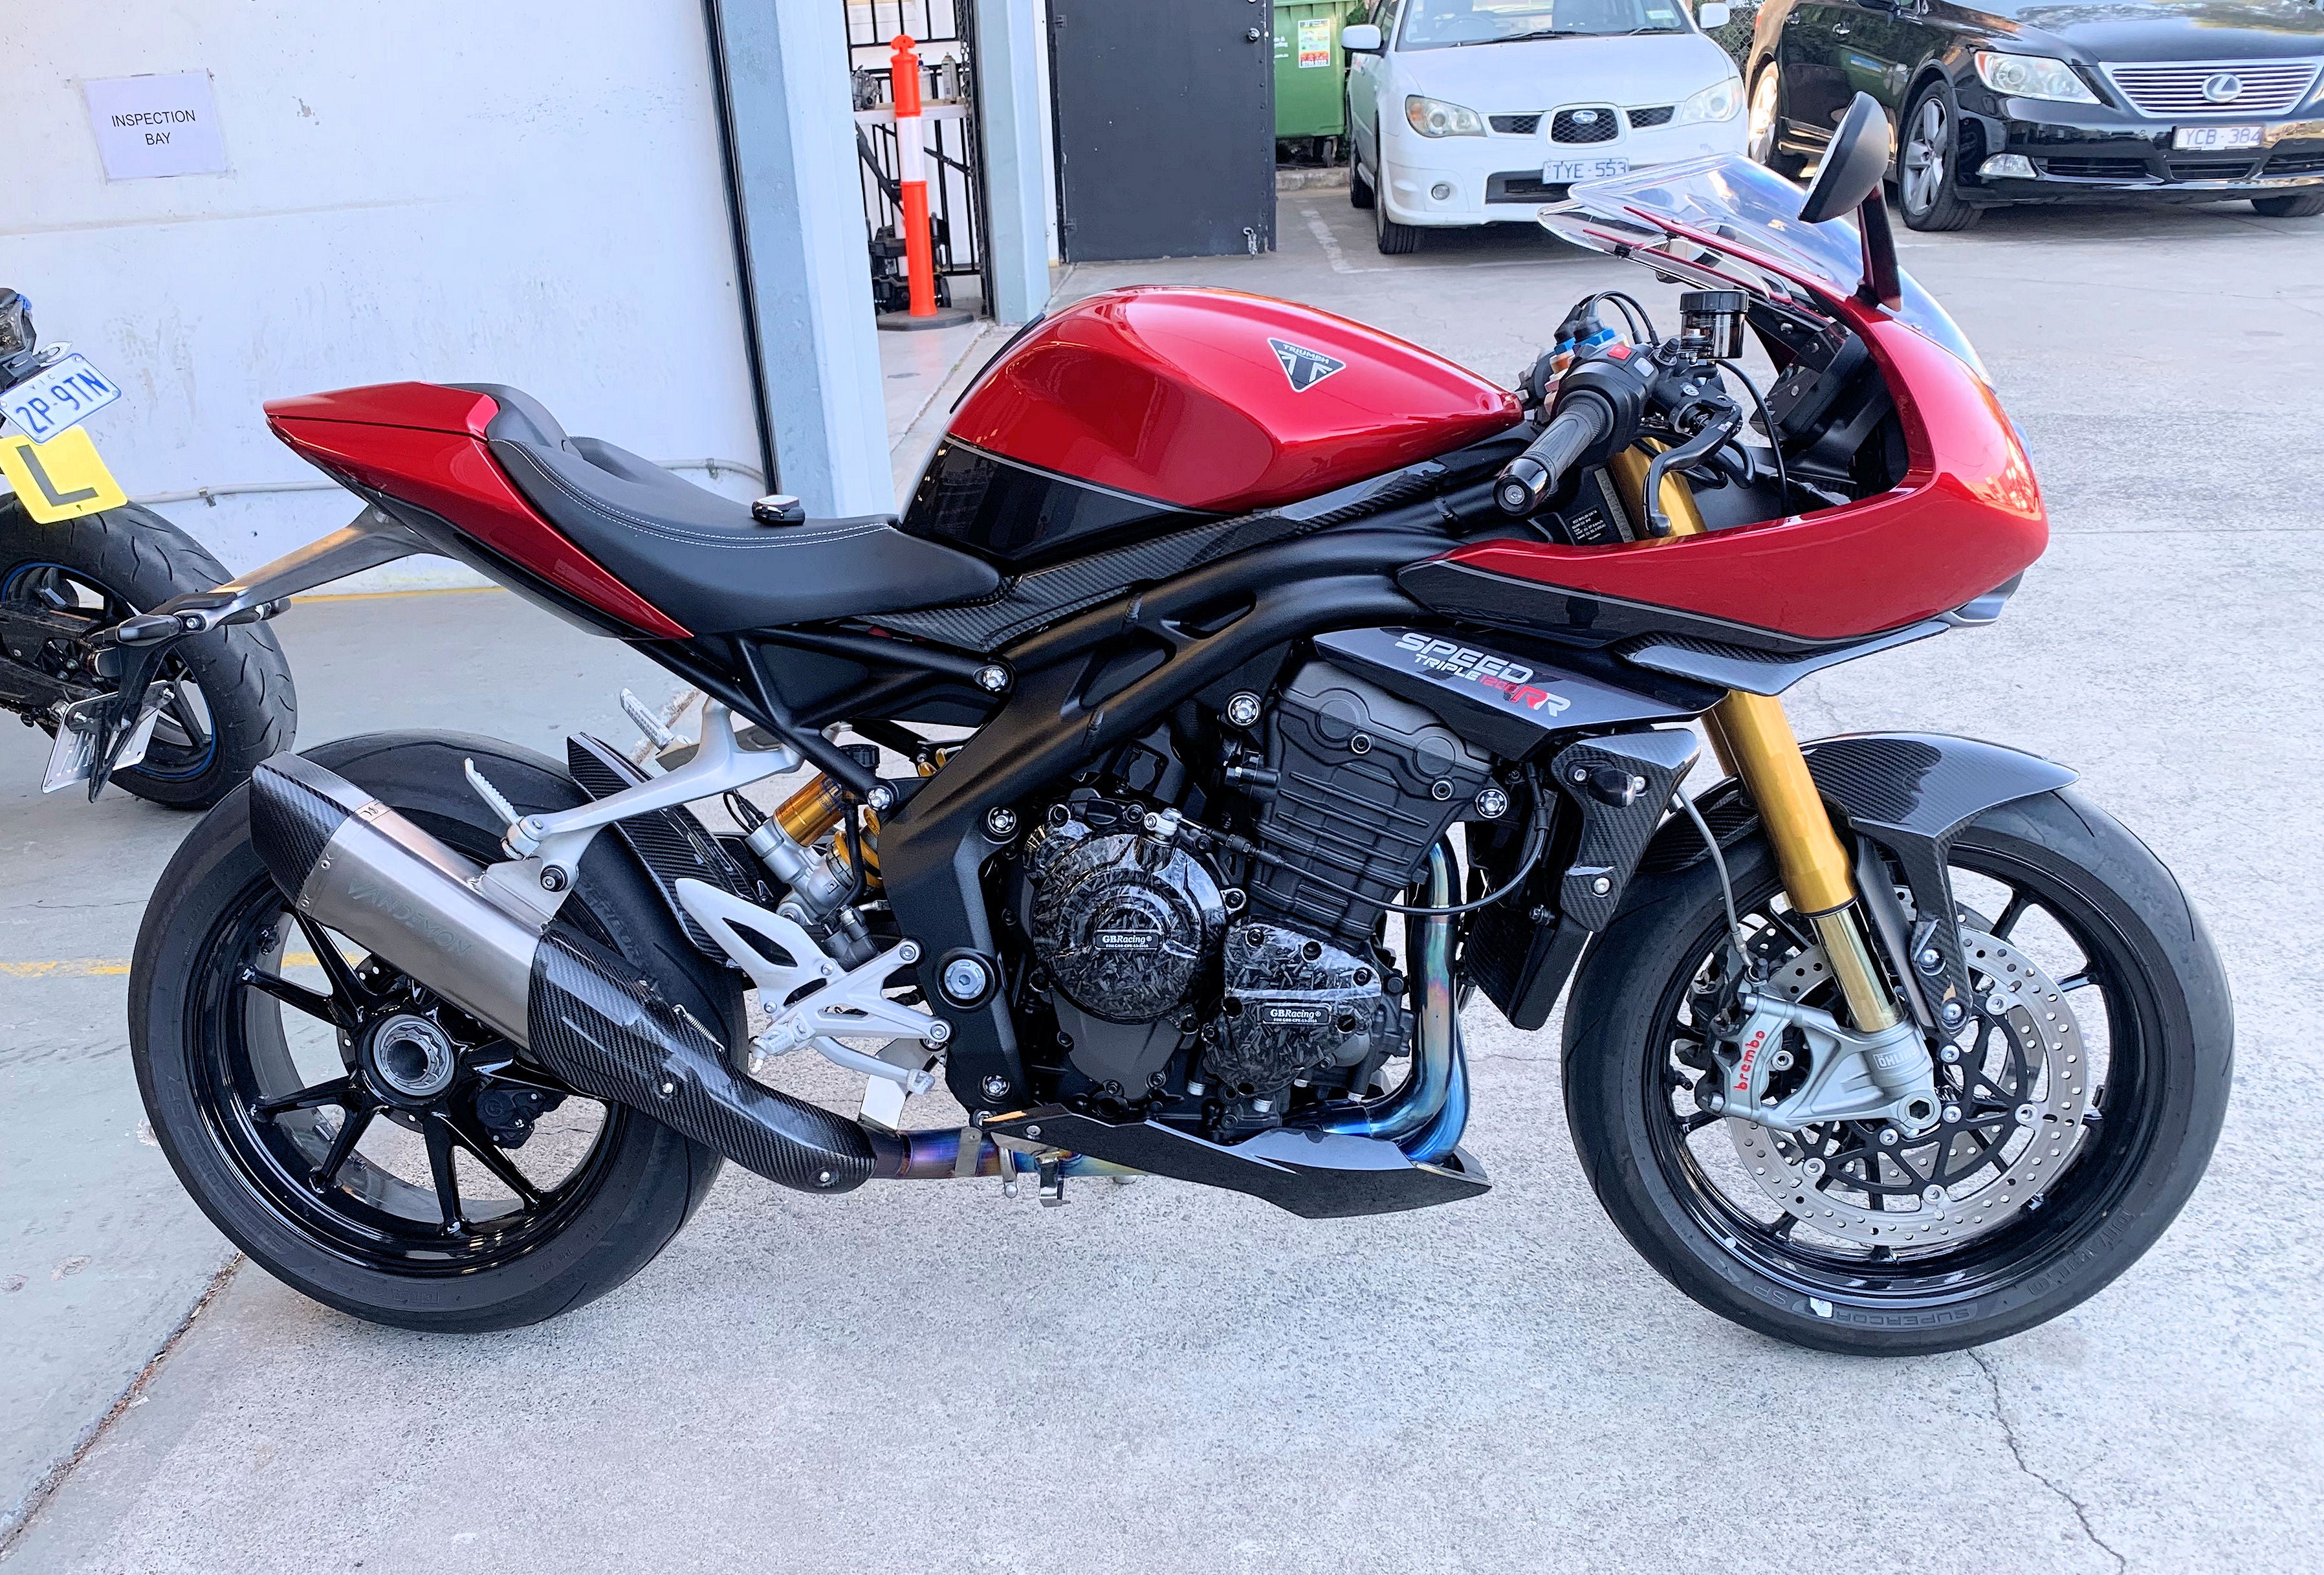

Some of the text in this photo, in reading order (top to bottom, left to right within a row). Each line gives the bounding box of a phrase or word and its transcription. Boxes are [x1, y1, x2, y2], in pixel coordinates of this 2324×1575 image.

[111, 109, 196, 127] INSPECTION
[145, 132, 171, 146] BAY
[1282, 344, 1330, 364] TRIUMPH
[16, 368, 111, 434] 2P-9TN
[16, 444, 100, 507] L
[1394, 632, 1534, 684] SPEED
[1414, 653, 1482, 681] TRIPLE
[1733, 1030, 1765, 1091] brembo
[1753, 1284, 1970, 1327] SUPERCOR SP
